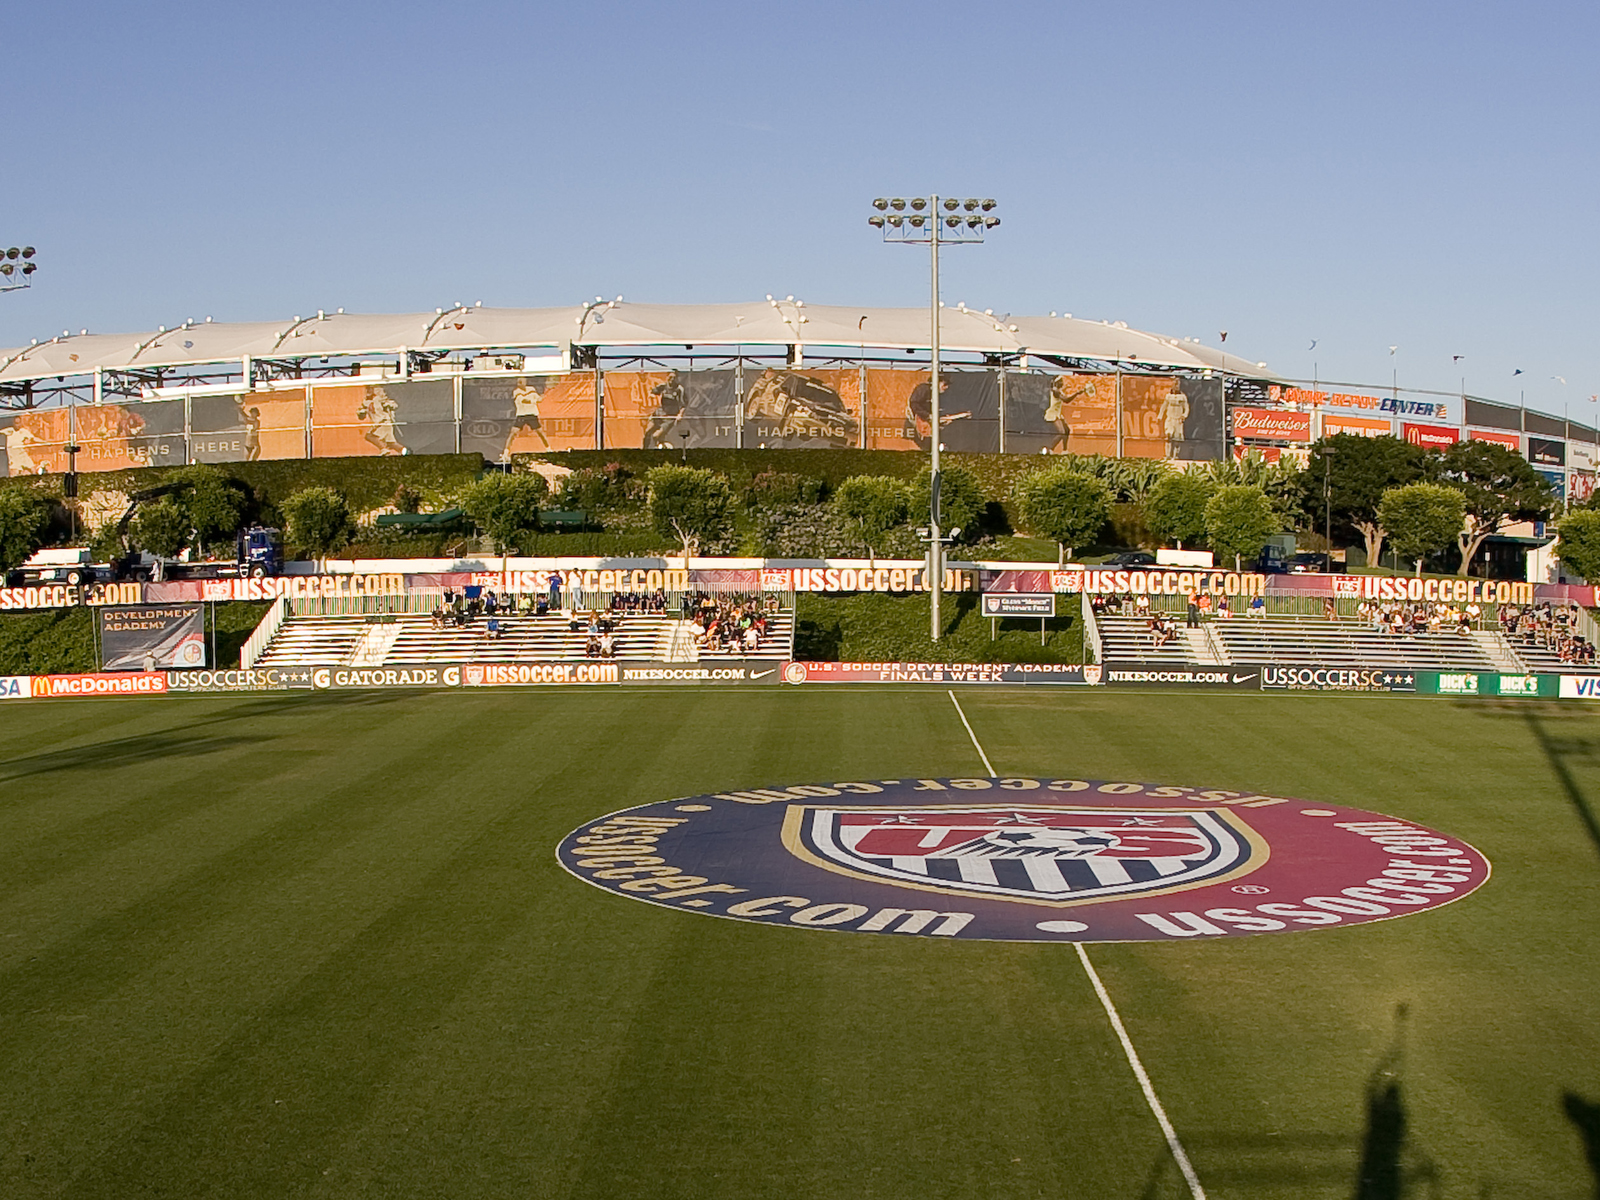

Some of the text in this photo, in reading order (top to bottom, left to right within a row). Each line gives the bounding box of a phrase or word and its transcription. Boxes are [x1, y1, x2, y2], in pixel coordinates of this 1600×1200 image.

[1380, 398, 1434, 415] CENTER
[1233, 410, 1309, 431] Budweiser
[715, 426, 915, 438] IT HAPPENS HERE
[90, 444, 170, 460] HAPPENS
[194, 440, 240, 453] HERE
[234, 574, 405, 600] ussoccer.com
[1085, 570, 1266, 596] ussoccer.com
[1364, 577, 1534, 605] ussoccer.com
[104, 608, 198, 621] DEVELOPMENT
[104, 621, 167, 631] ACADEMY
[485, 664, 619, 683] ussoccer.com
[623, 669, 746, 680] NIKESOCCER.COM
[809, 663, 1082, 673] U.S. SOCCER DEVELOPMENT ACADEMY
[880, 671, 1003, 681] FINALS WEEK
[52, 675, 164, 694] McDonald's
[167, 669, 279, 687] USSOCCERSC
[335, 669, 438, 686] GATORADE
[1108, 671, 1229, 683] NIKESOCCER.COM
[1263, 668, 1383, 687] USSOCCERSC
